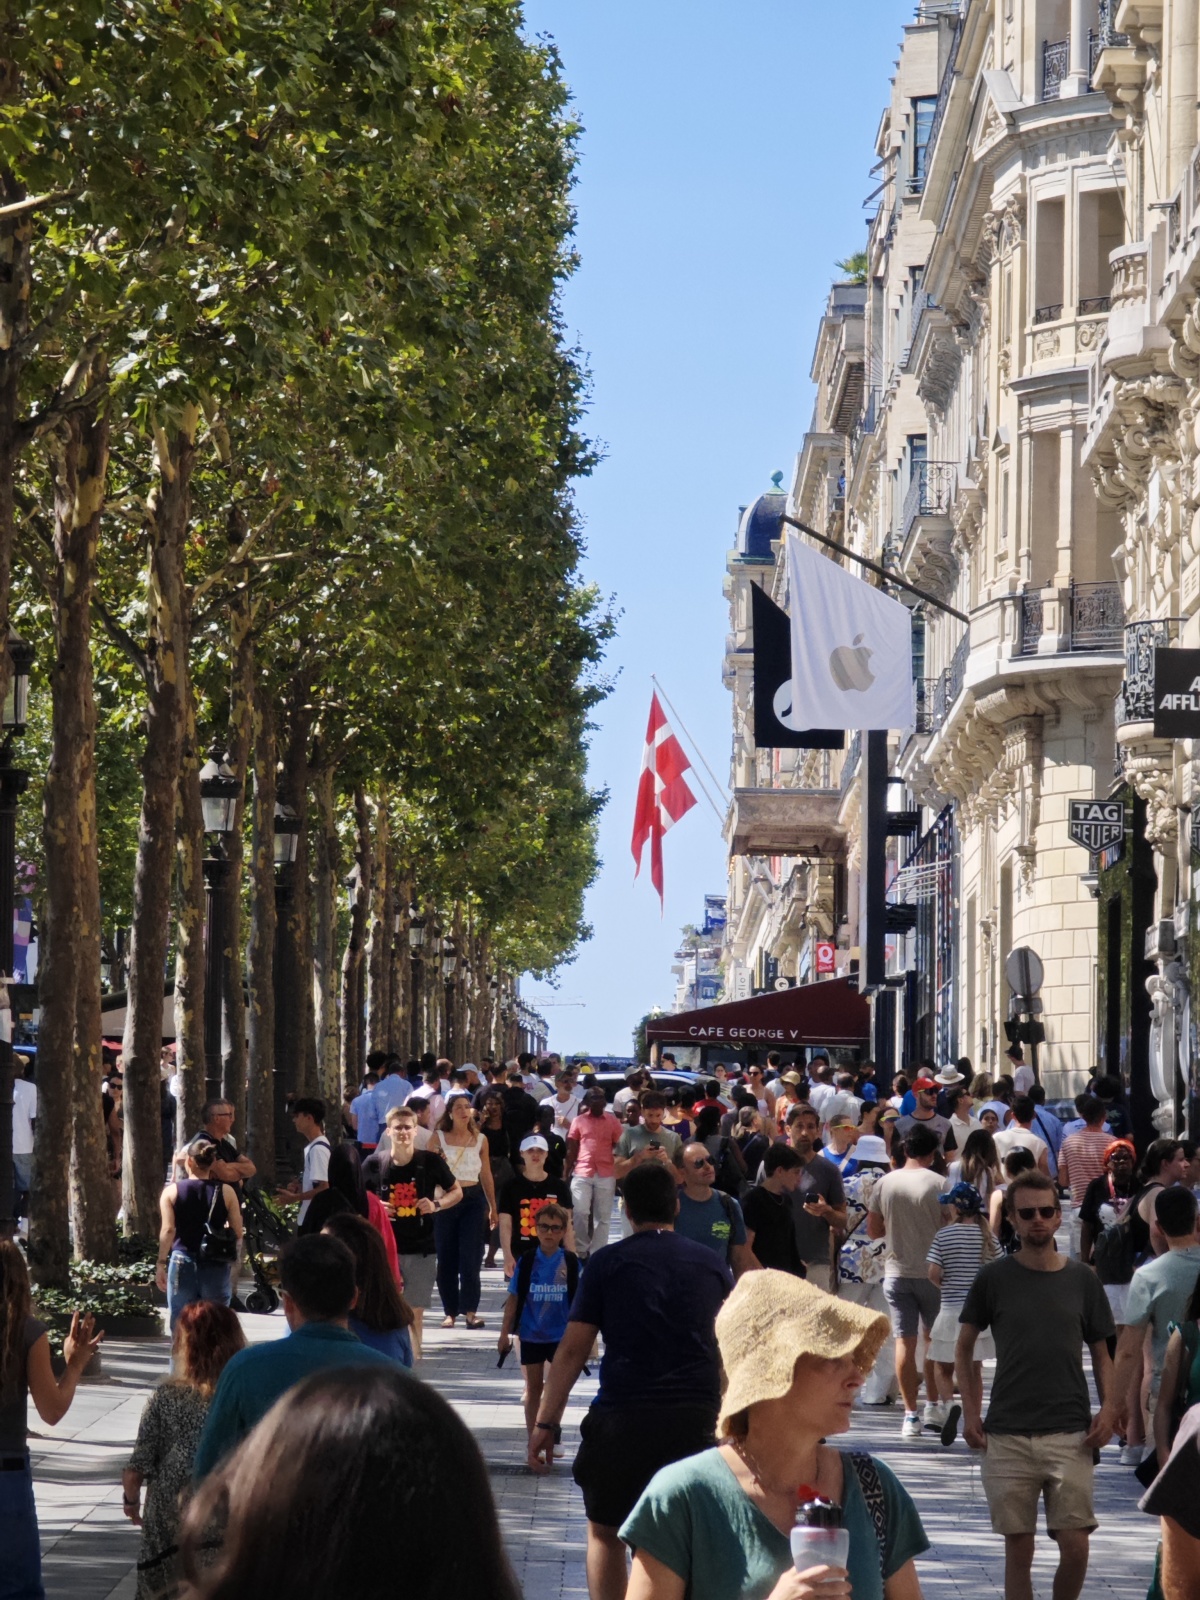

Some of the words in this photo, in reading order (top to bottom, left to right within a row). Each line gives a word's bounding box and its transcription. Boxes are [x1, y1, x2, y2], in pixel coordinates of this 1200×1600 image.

[1159, 693, 1200, 711] AFFL
[1074, 803, 1118, 821] TAG
[1072, 824, 1120, 849] HEUER
[818, 945, 834, 964] Q
[688, 1026, 724, 1037] CAFE
[729, 1027, 785, 1039] GEORGE
[790, 1029, 799, 1039] V
